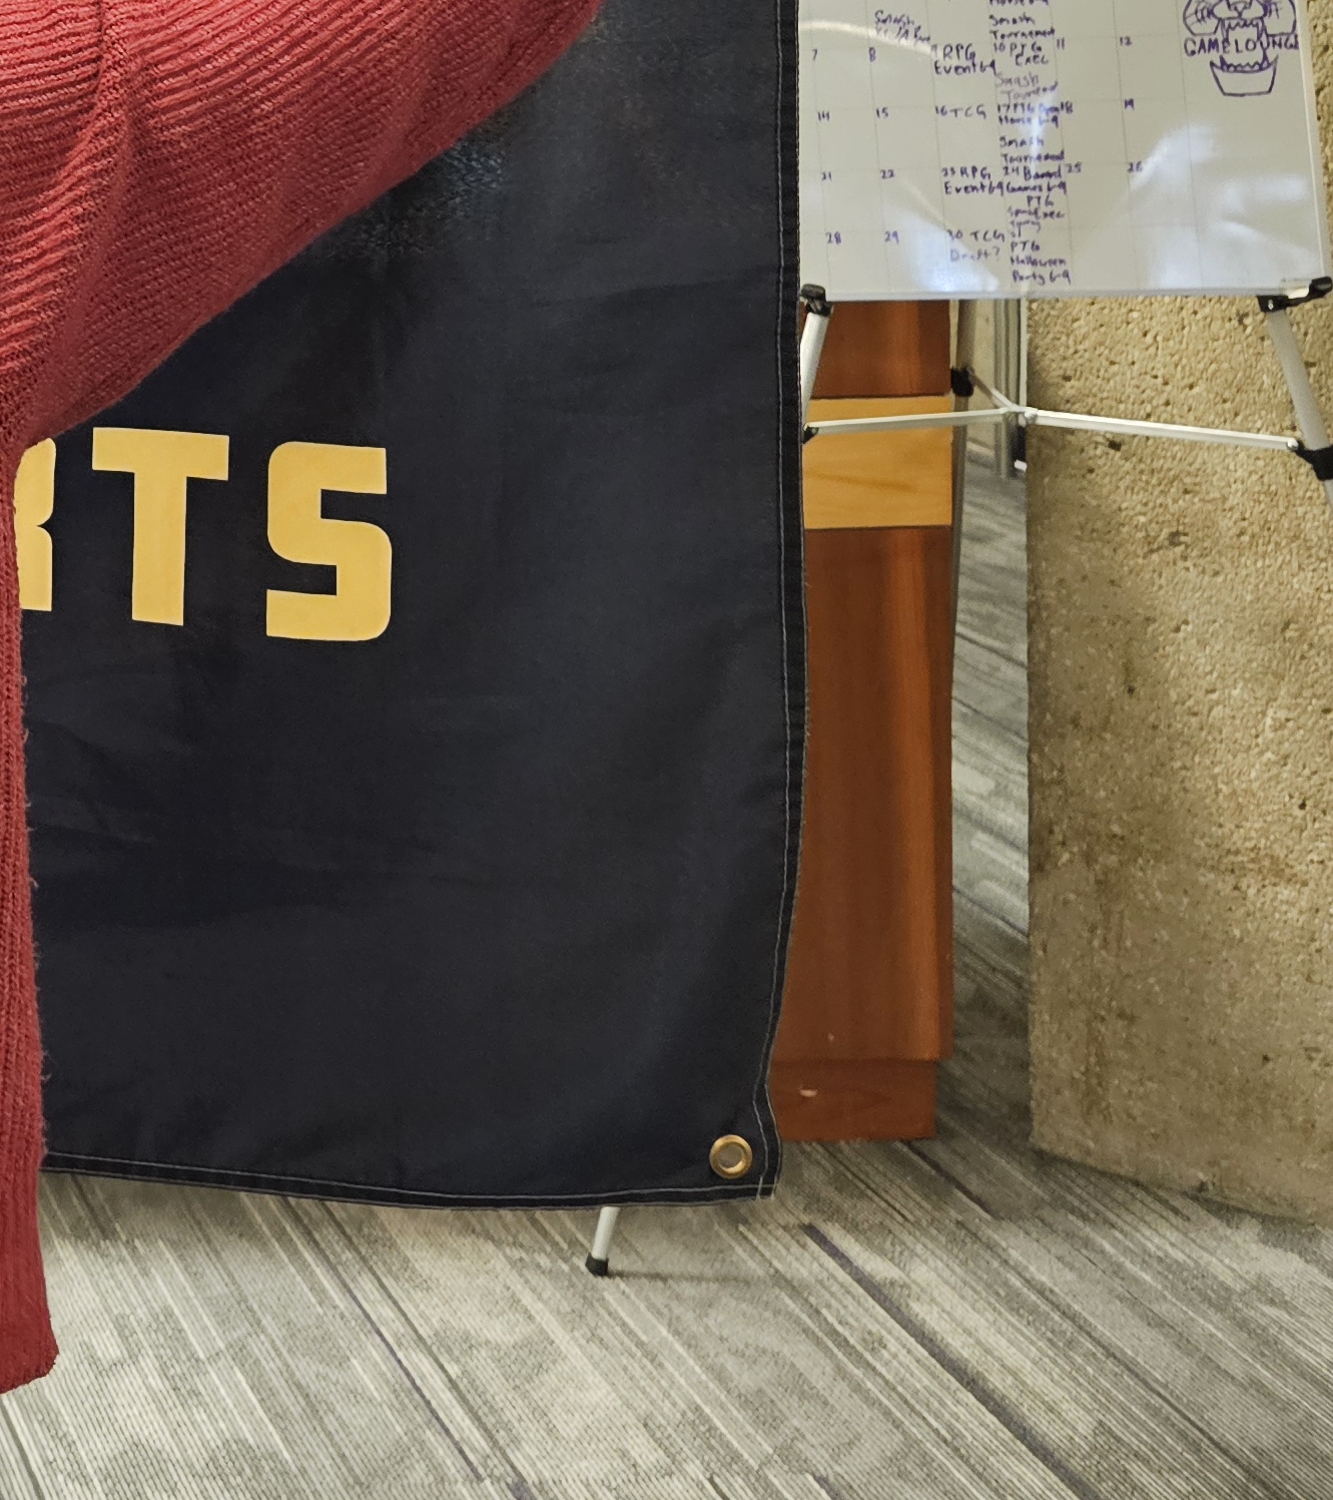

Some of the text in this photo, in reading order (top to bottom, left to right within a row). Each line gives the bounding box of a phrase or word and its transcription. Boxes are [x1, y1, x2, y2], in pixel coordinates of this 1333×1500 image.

[942, 43, 976, 61] RPG
[950, 105, 987, 119] TCG
[969, 229, 1005, 243] TCG
